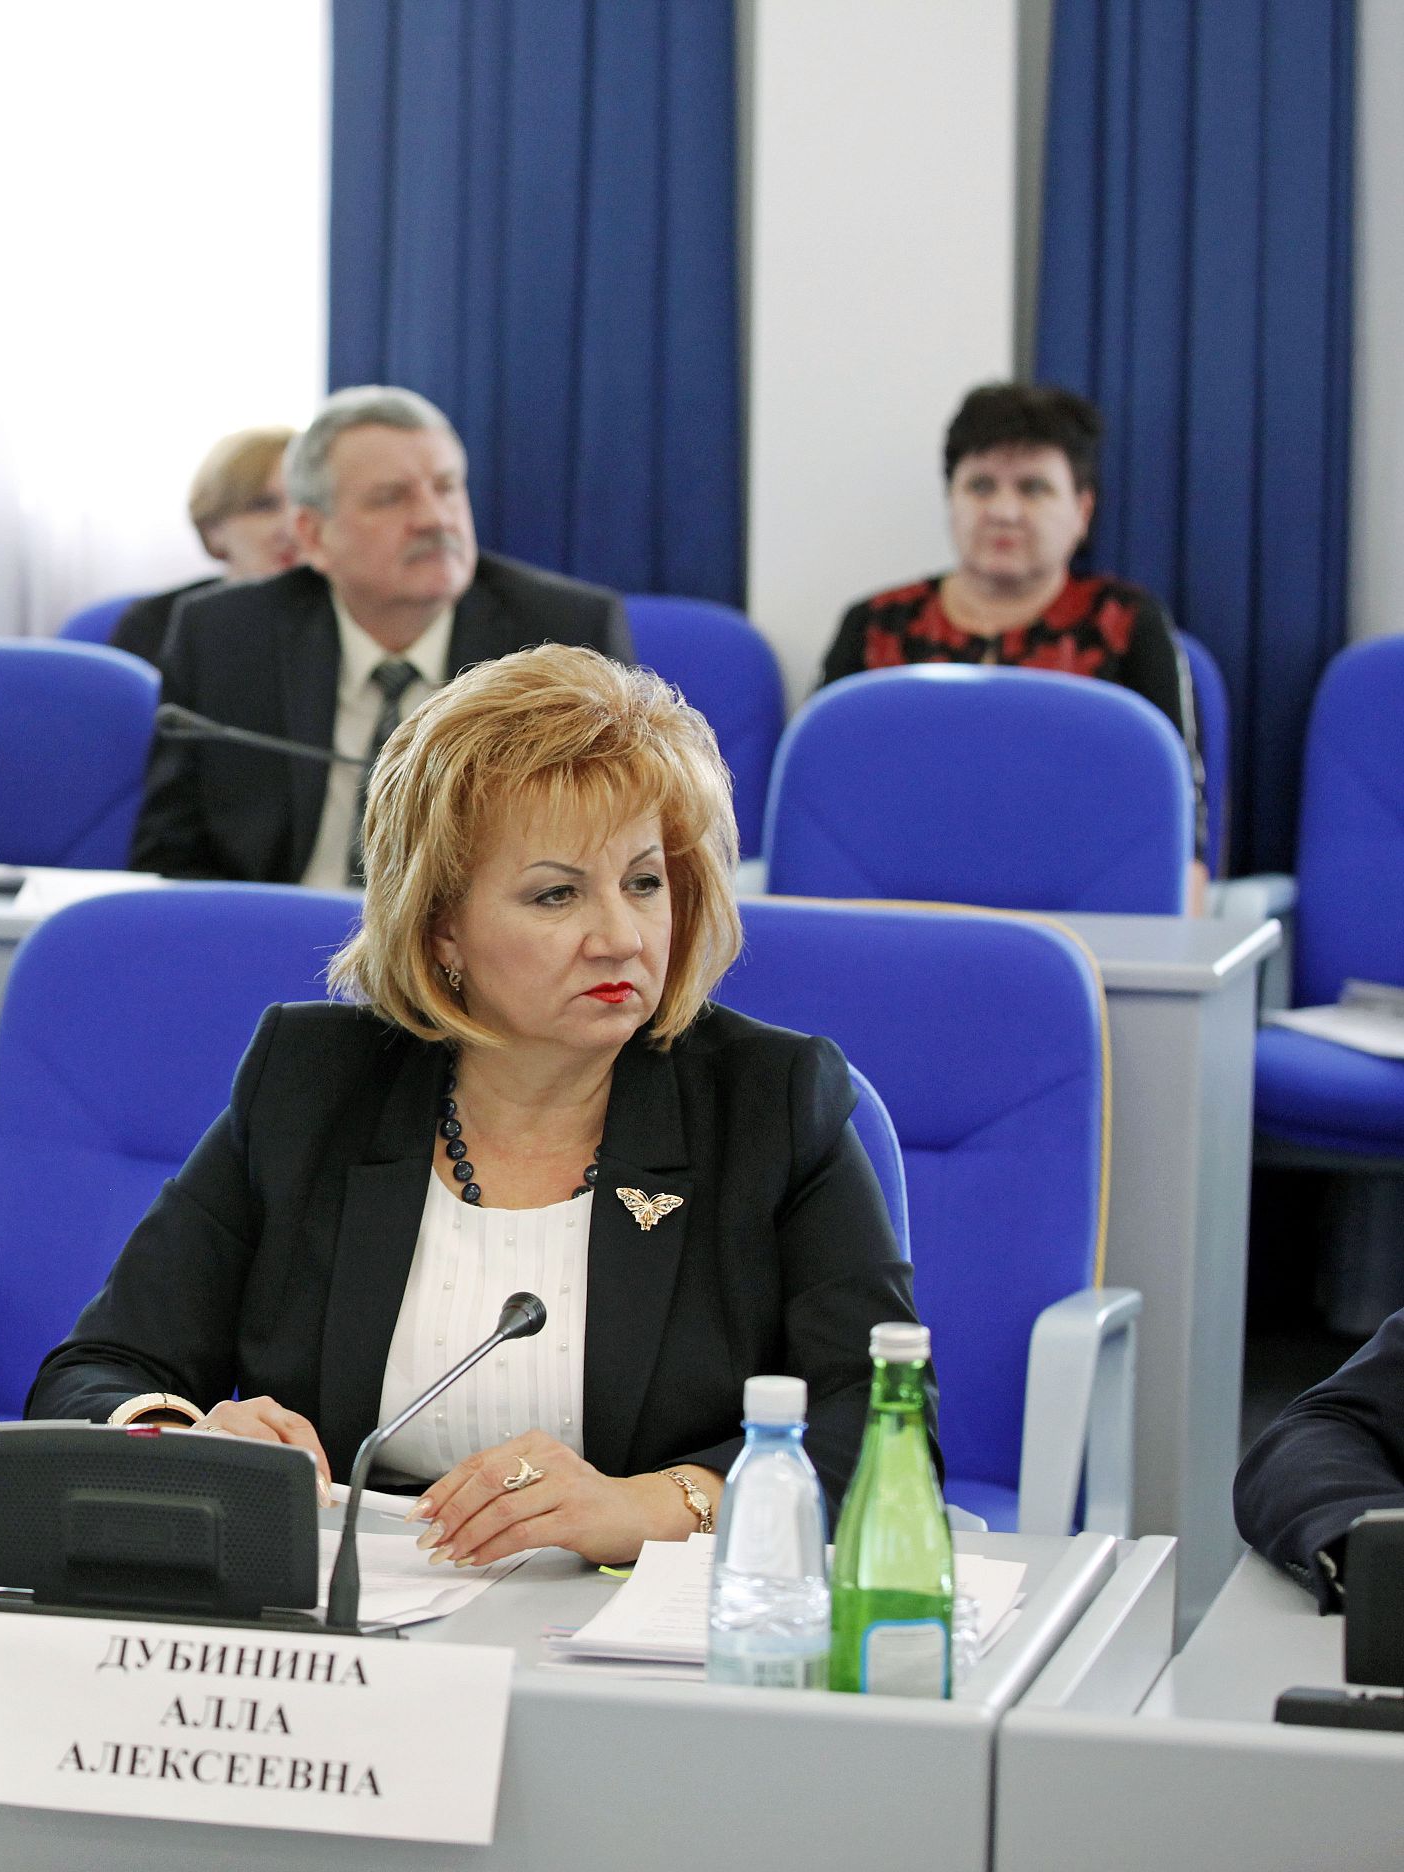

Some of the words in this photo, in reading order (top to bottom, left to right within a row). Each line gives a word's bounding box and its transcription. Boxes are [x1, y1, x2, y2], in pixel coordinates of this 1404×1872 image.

[97, 1634, 368, 1686] ДУБИНИНА
[160, 1695, 292, 1734] АЛЛА
[56, 1741, 382, 1796] АЛЕКСЕЕВНА
